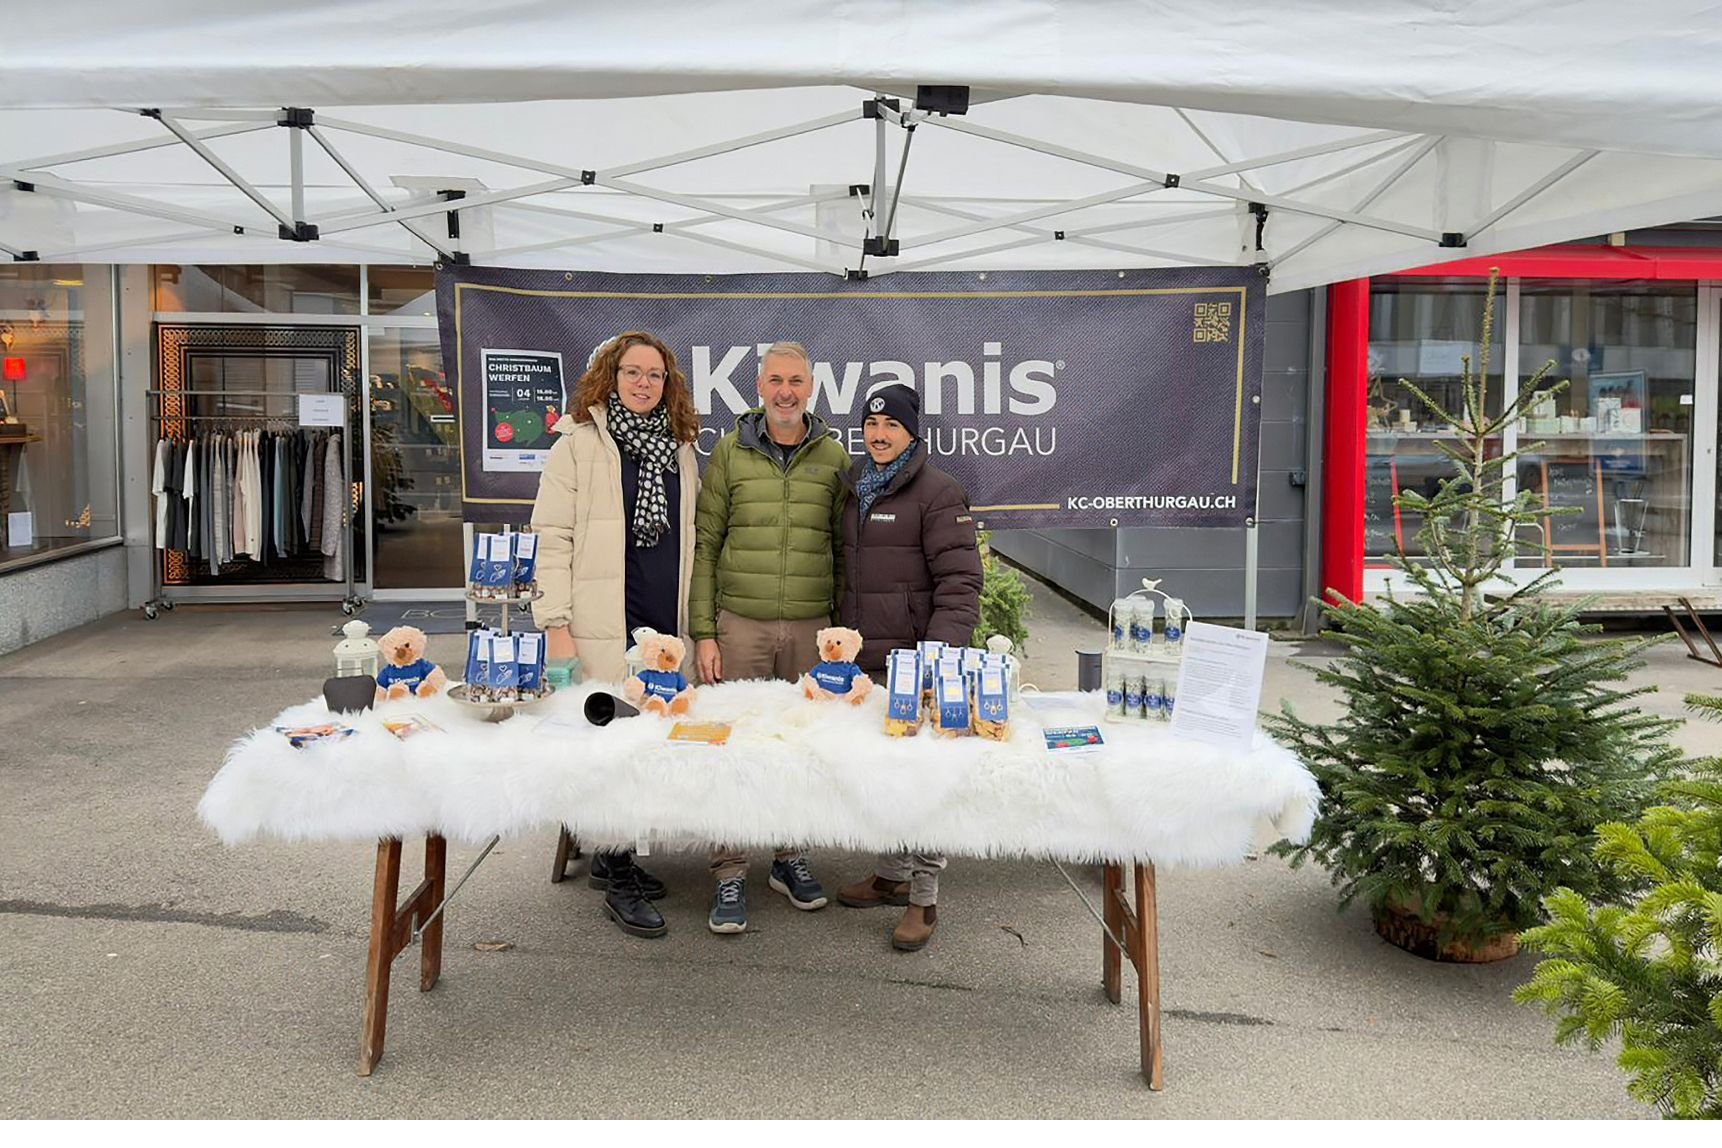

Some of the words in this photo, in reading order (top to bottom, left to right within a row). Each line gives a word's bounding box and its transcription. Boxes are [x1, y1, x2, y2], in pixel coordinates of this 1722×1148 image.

[488, 363, 552, 374] CHRISTBAUM
[488, 373, 531, 382] WERFEN
[1067, 495, 1236, 510] KC-OBERTHURGAU.CH
